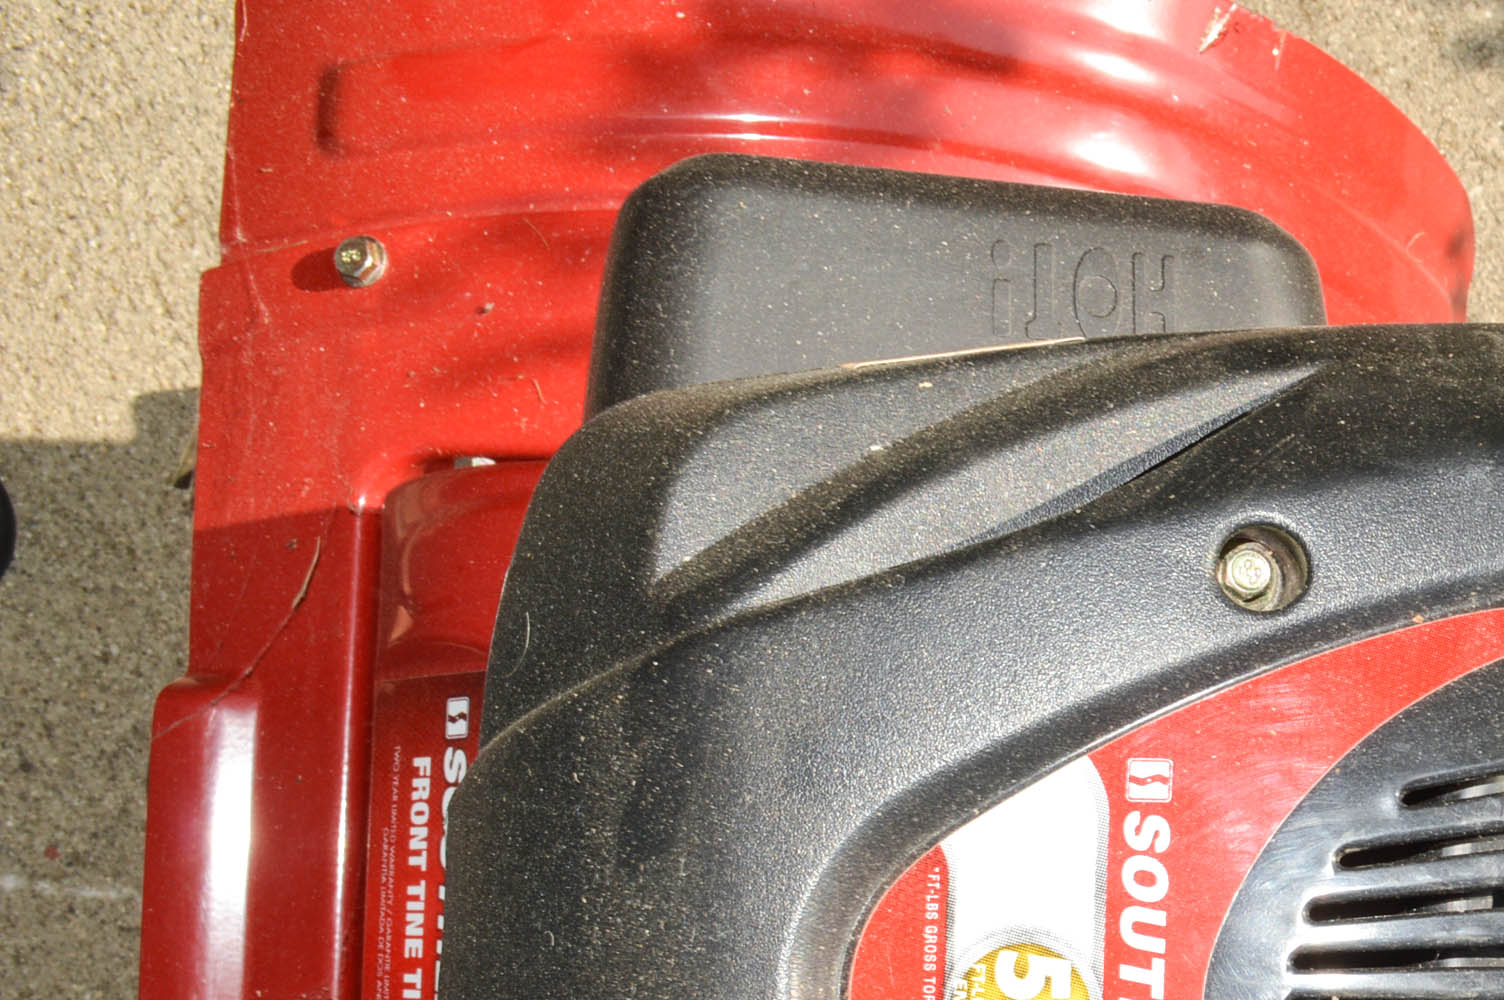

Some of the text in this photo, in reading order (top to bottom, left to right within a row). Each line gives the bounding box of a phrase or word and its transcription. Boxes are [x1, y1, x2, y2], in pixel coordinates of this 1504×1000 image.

[393, 745, 401, 771] TWO
[390, 804, 398, 842] LIMITED
[408, 757, 431, 871] FRONT
[387, 846, 396, 905] WARRANTY
[404, 880, 425, 958] TINE
[923, 925, 938, 971] GROSS
